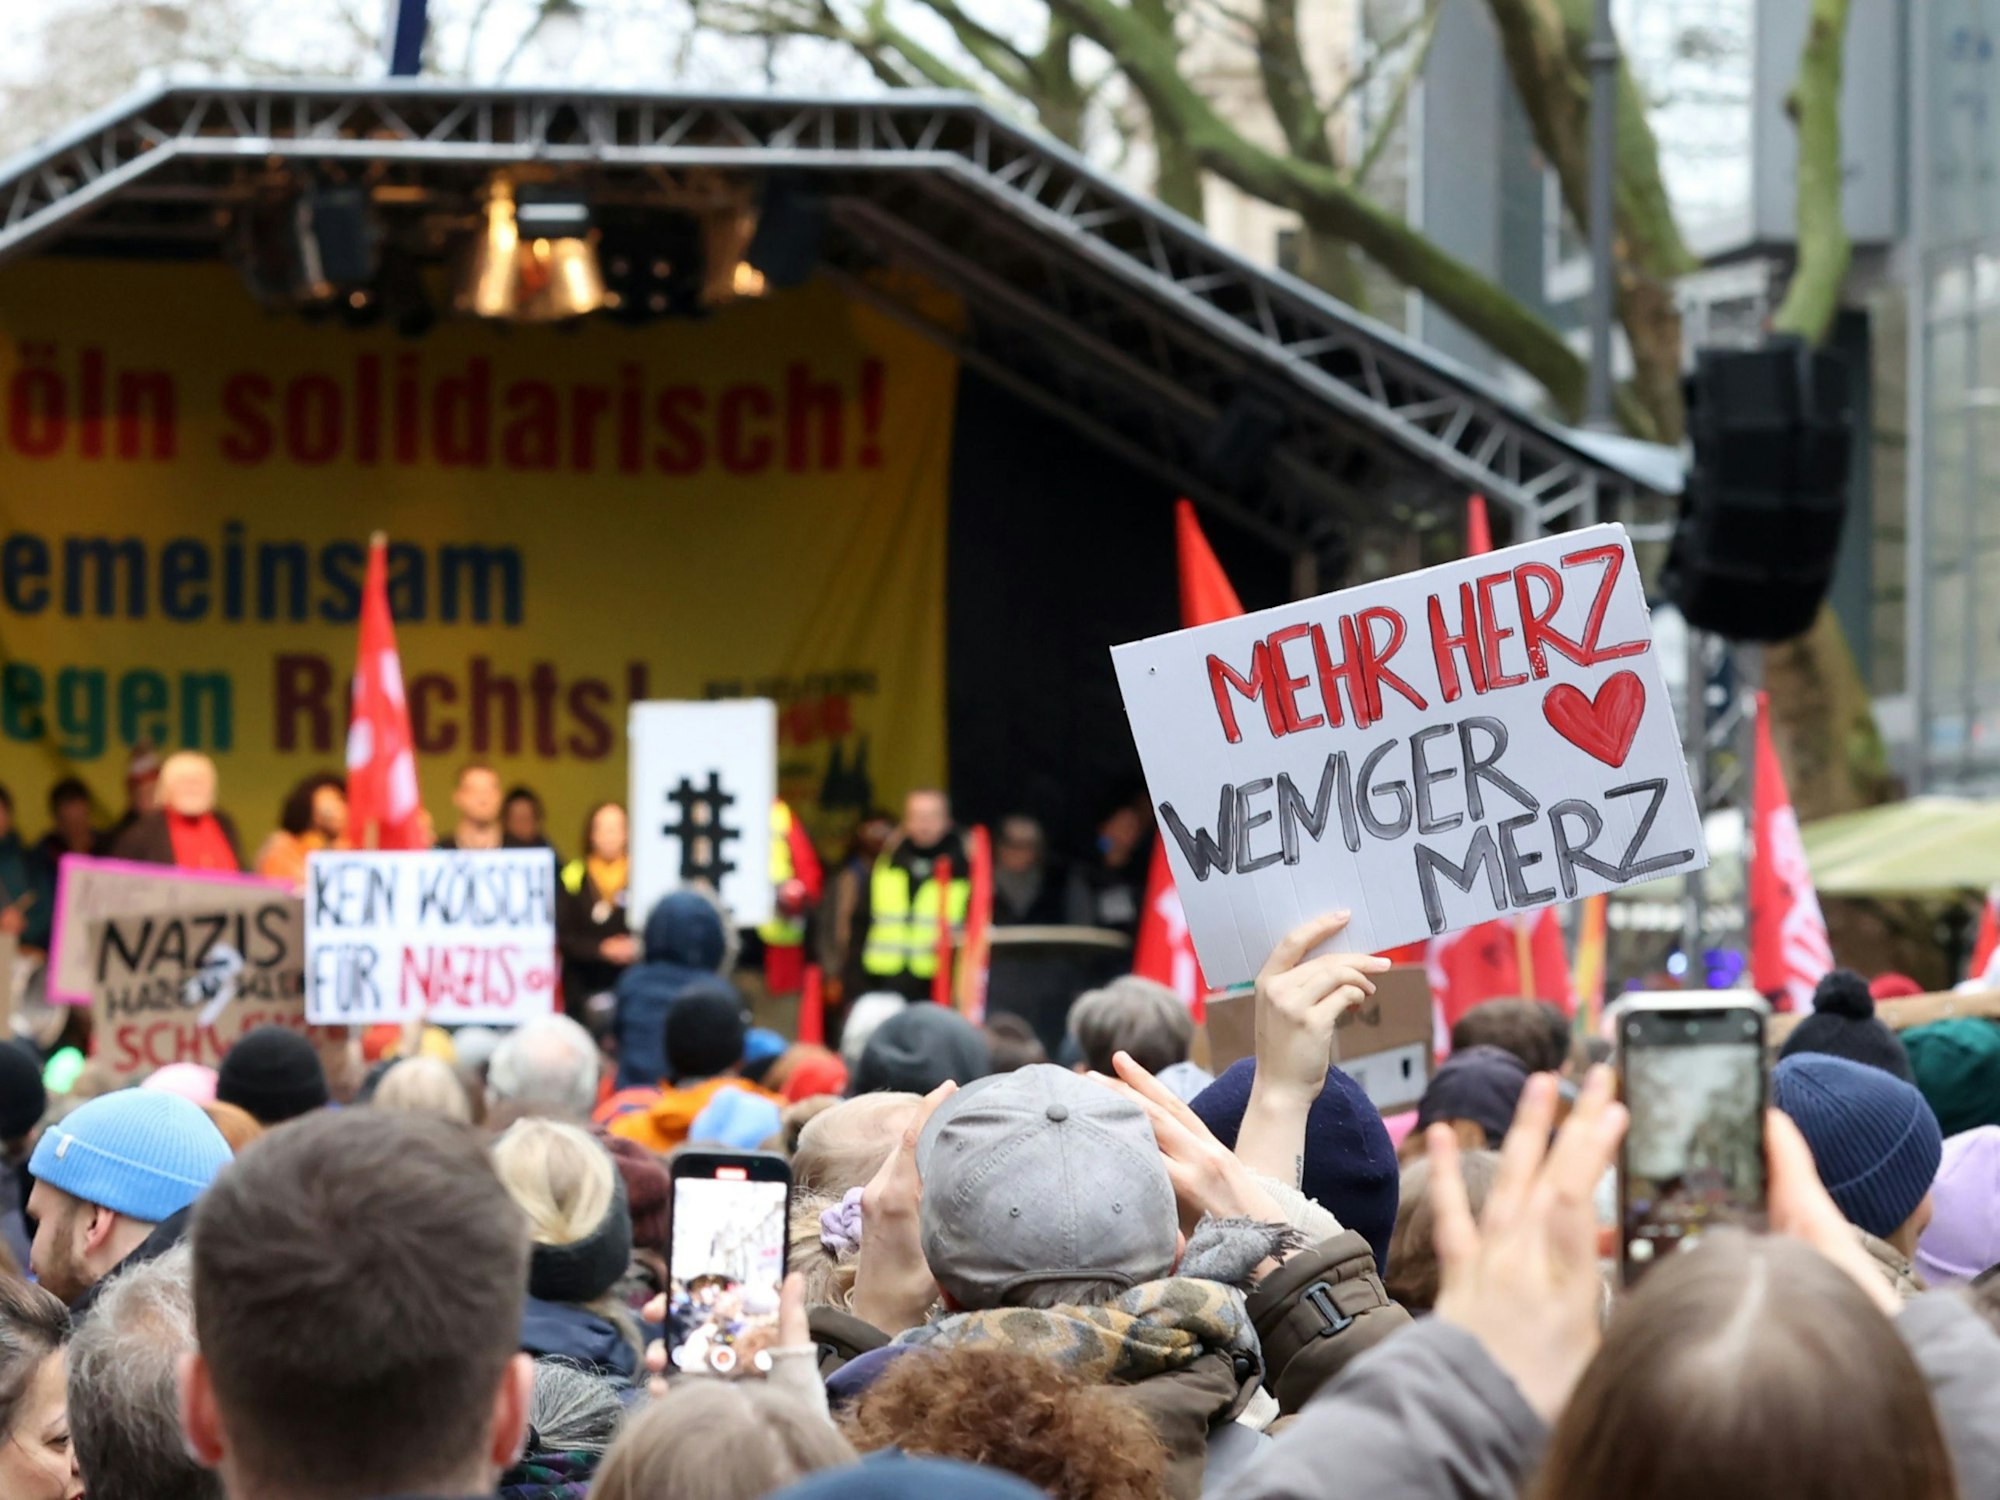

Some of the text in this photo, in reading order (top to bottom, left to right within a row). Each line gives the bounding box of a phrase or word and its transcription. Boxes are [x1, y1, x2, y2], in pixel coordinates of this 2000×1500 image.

[219, 351, 888, 477] solidarisch!
[1206, 543, 1651, 744] MEHR HERZ
[274, 654, 648, 761] Rchts
[1157, 715, 1540, 882] WENIGER
[1413, 777, 1696, 935] MERZ
[96, 904, 290, 982] NAZIS
[313, 861, 398, 927] KEIN
[313, 943, 520, 1013] FÜR NAZIS
